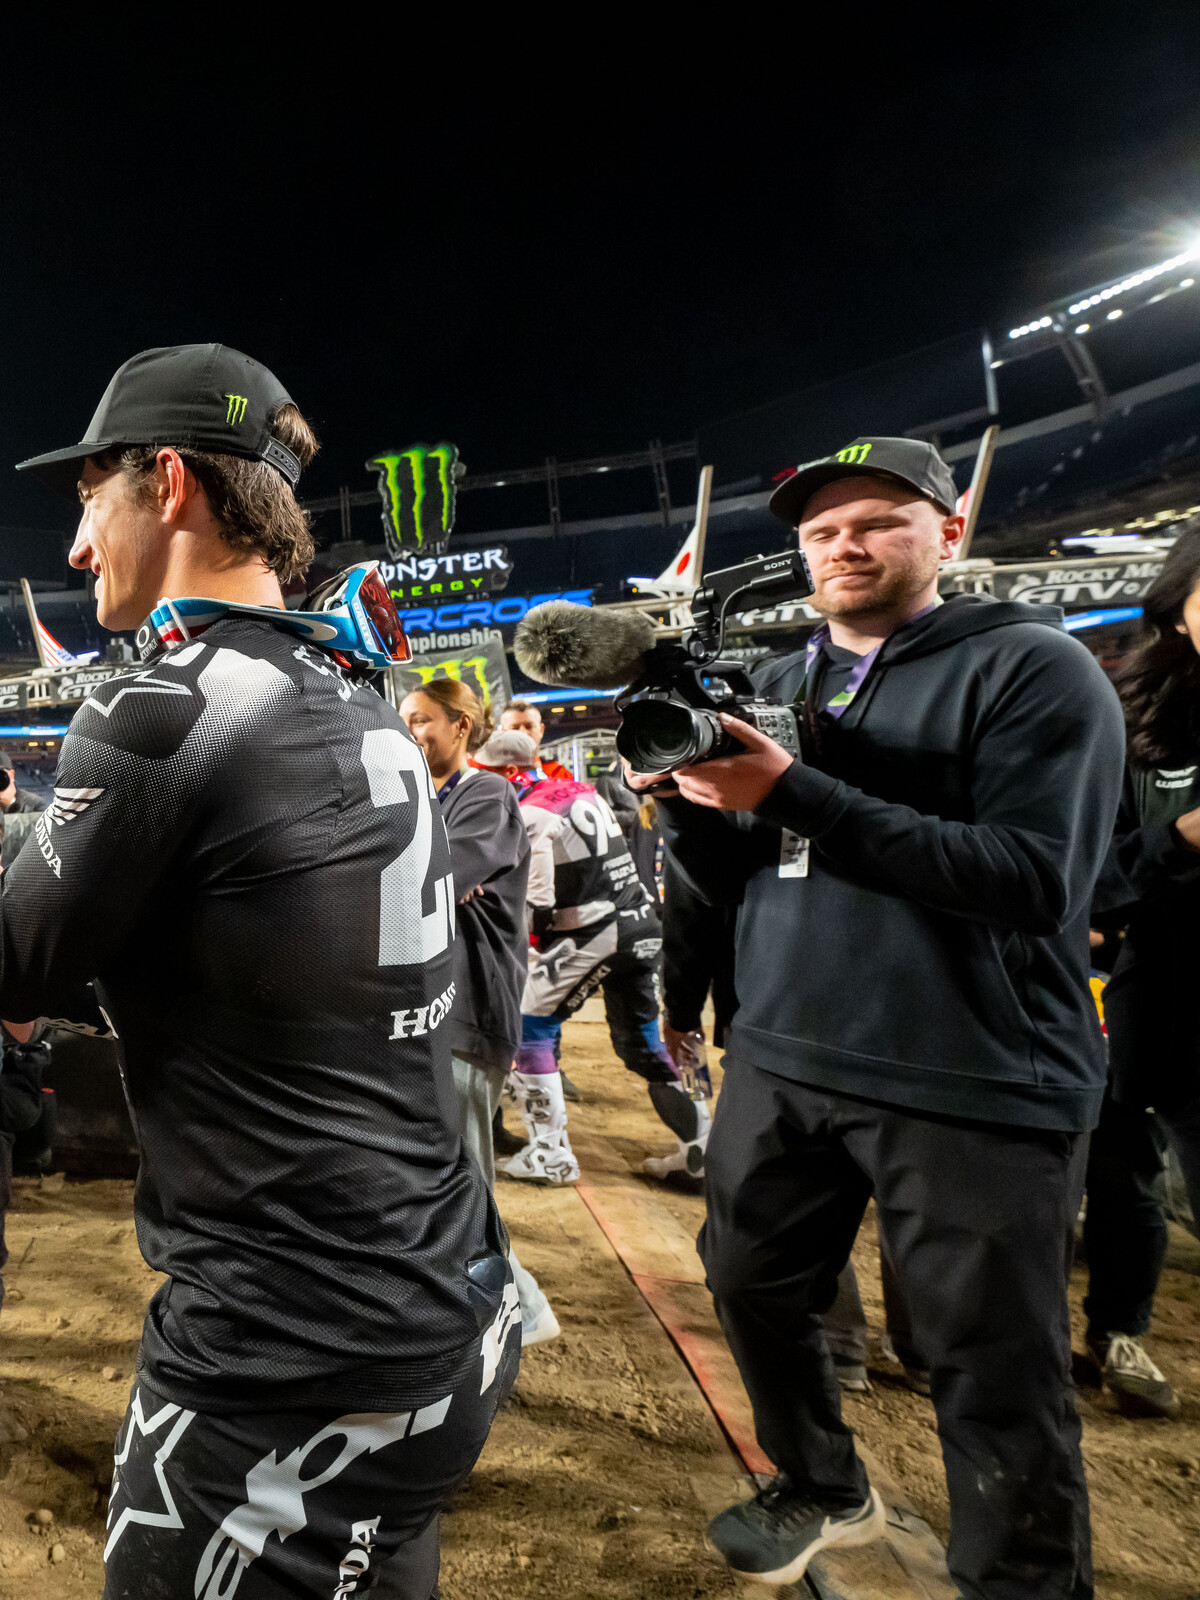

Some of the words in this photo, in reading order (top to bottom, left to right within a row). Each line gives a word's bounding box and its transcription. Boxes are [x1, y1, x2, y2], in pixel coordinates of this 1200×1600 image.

[763, 558, 793, 571] SONY
[1045, 568, 1122, 584] ROCKY
[353, 601, 373, 648] OAKLEY
[75, 671, 113, 685] ROCKY
[34, 816, 63, 880] ONDA
[361, 728, 456, 967] 2
